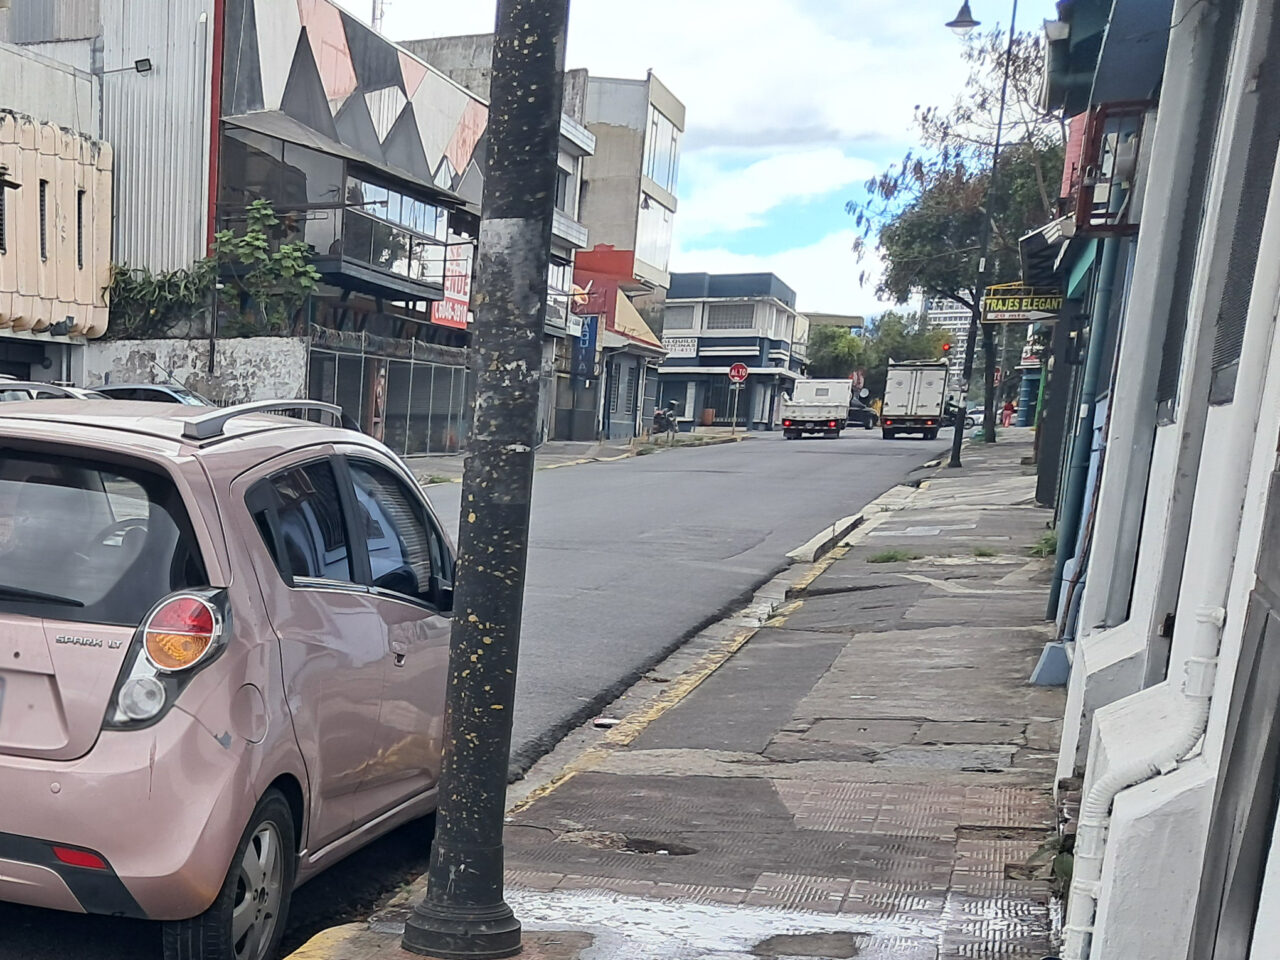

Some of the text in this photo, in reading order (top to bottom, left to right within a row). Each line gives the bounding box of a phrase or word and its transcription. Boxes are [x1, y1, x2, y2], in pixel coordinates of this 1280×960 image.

[449, 246, 462, 267] SE
[445, 268, 469, 296] ENDE
[985, 298, 1020, 311] TRAJES
[56, 634, 122, 649] SPARK LT
